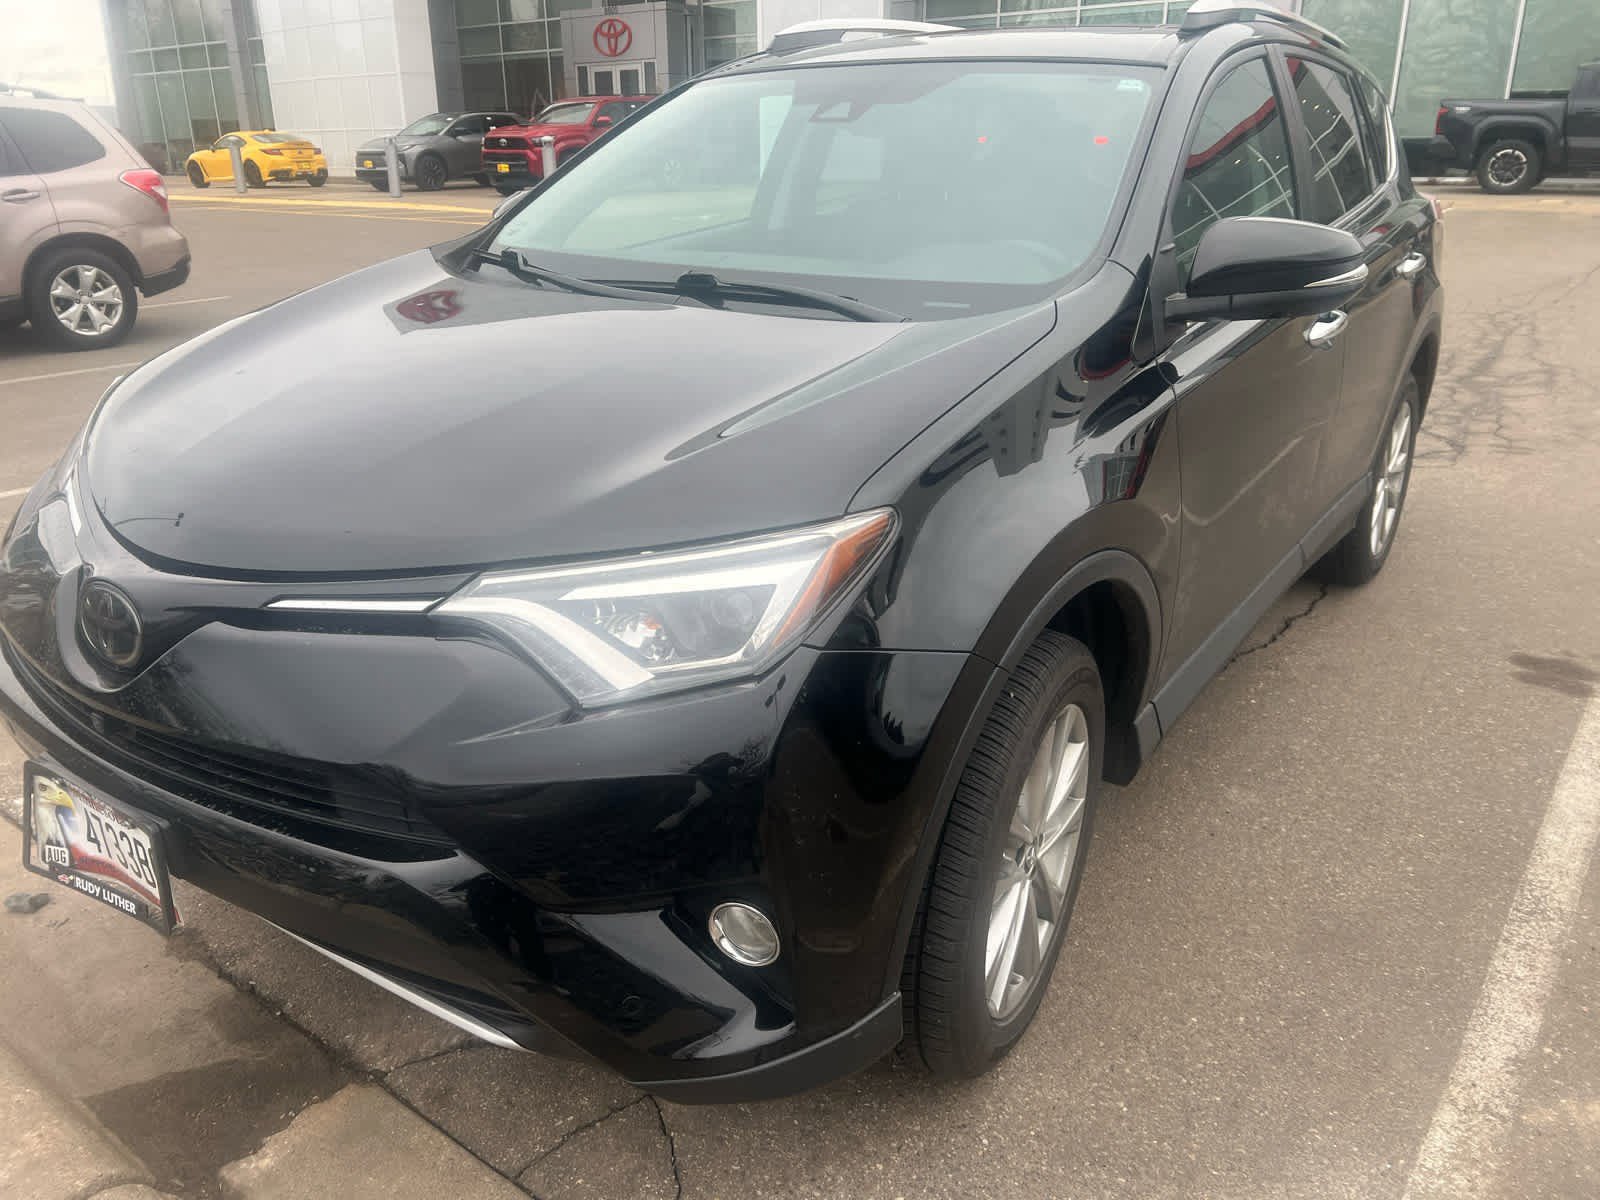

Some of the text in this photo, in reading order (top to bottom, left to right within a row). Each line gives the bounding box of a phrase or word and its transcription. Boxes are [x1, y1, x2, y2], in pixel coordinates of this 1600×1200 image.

[46, 847, 67, 864] AUG
[75, 876, 136, 915] RUDY LUTHER
